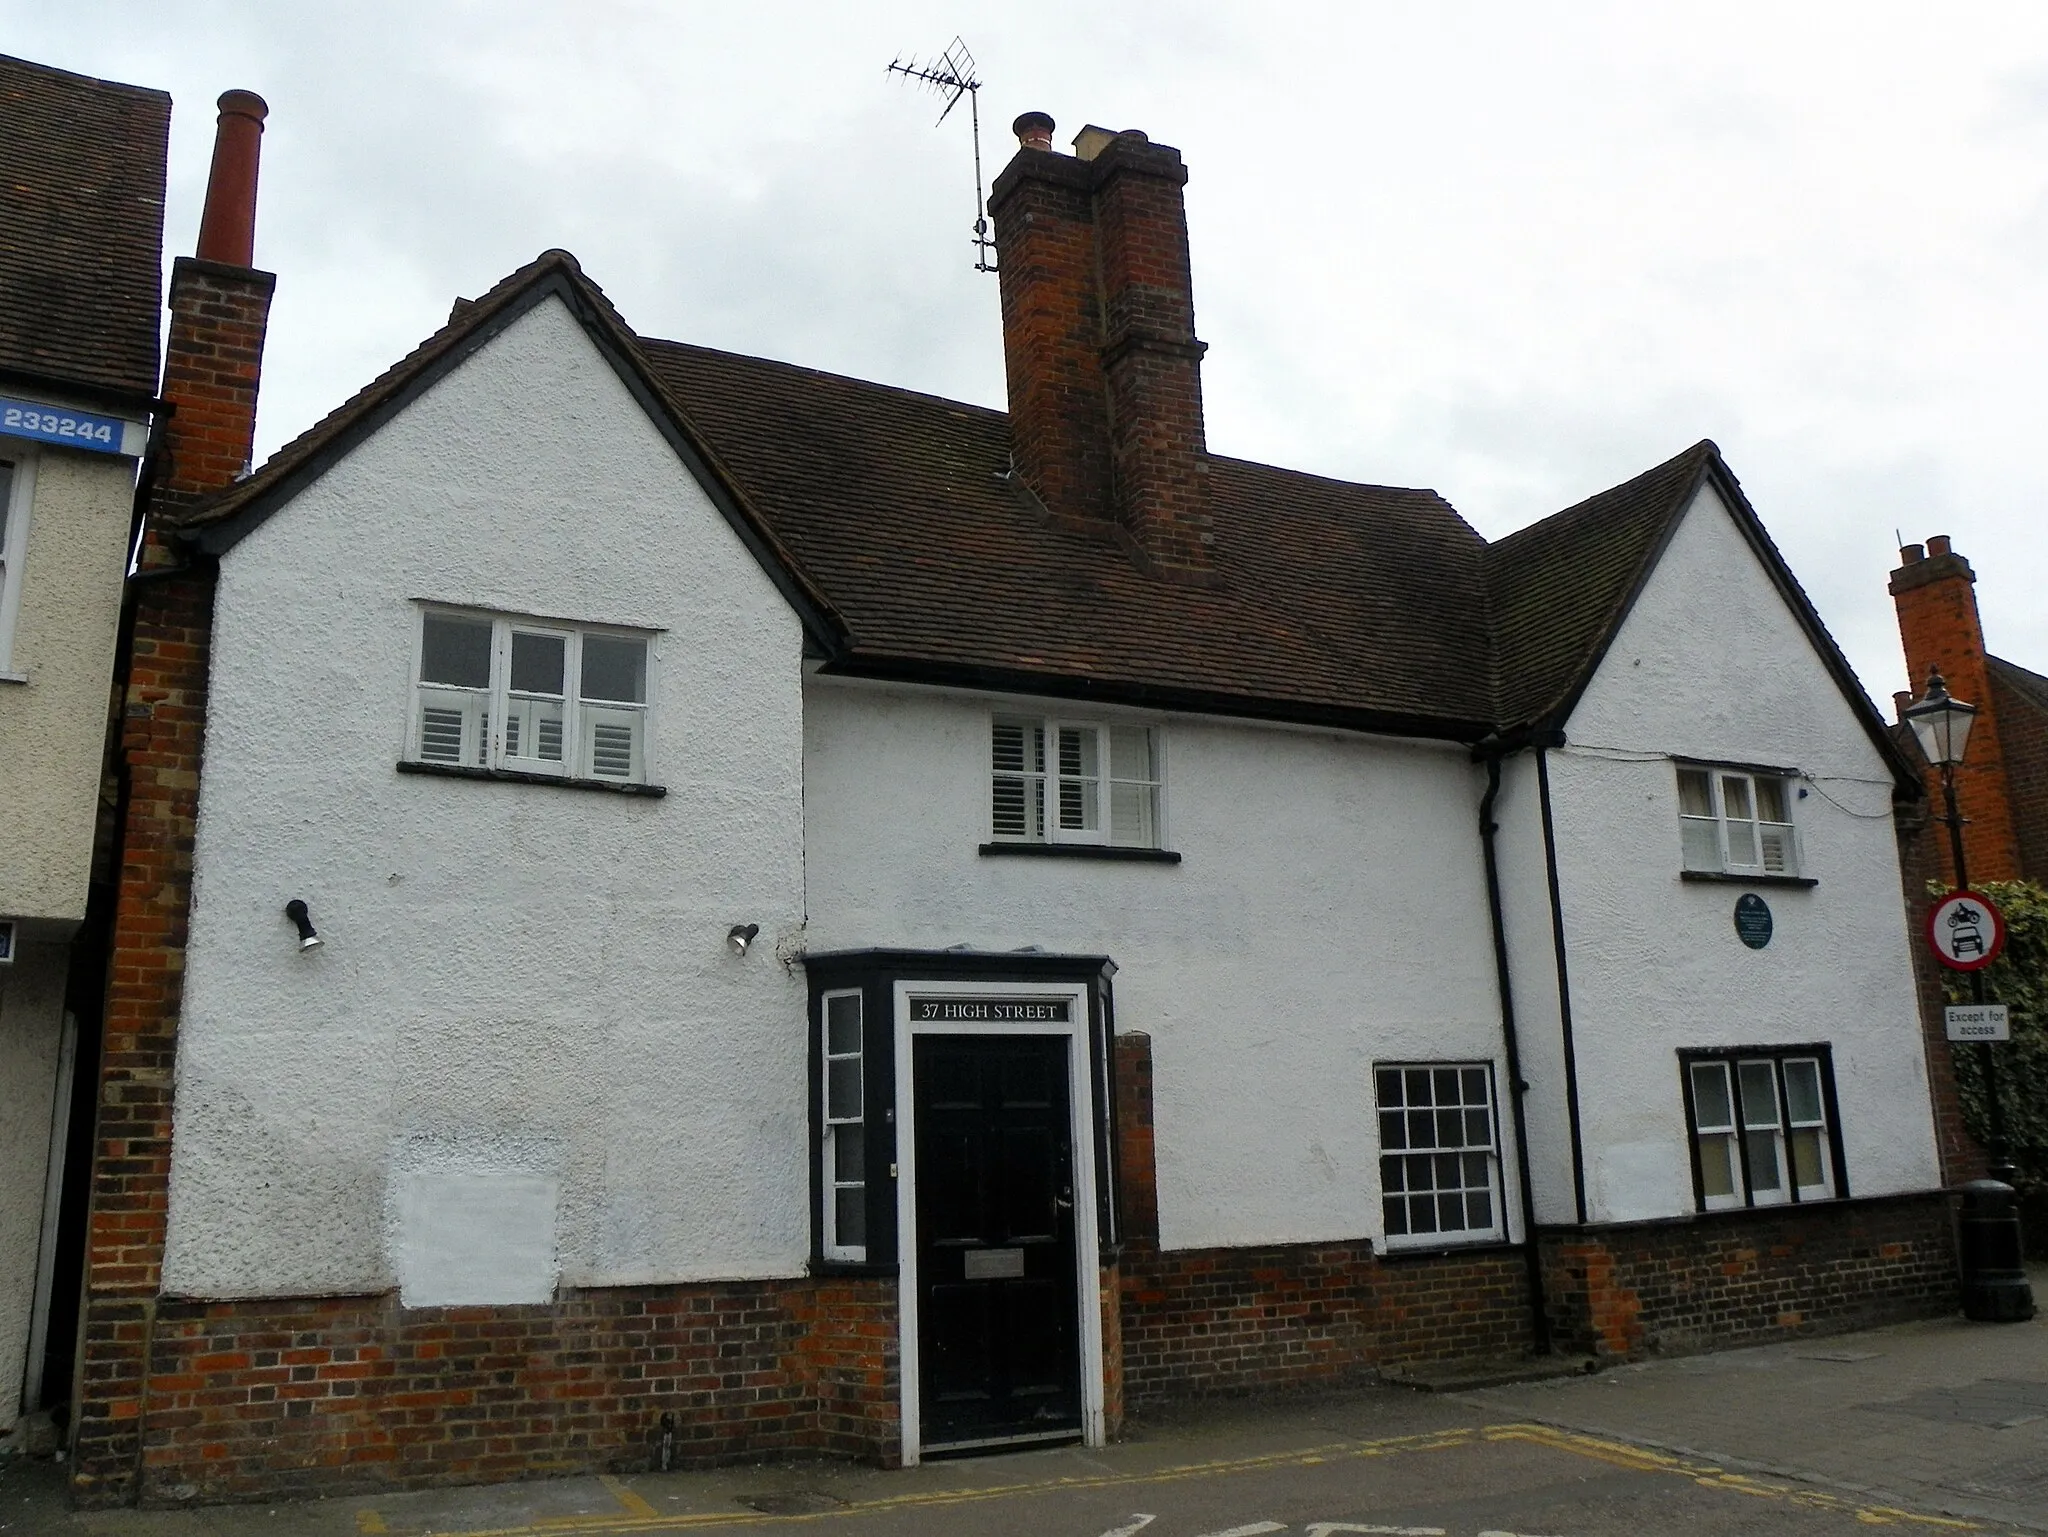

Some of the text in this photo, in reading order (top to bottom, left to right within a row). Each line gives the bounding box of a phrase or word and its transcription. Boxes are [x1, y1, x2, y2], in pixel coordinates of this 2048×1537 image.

[4, 408, 112, 443] 233244
[922, 1003, 1057, 1019] 37 HIGH STREET
[1948, 1010, 2004, 1024] Except for
[1960, 1026, 1996, 1036] access
